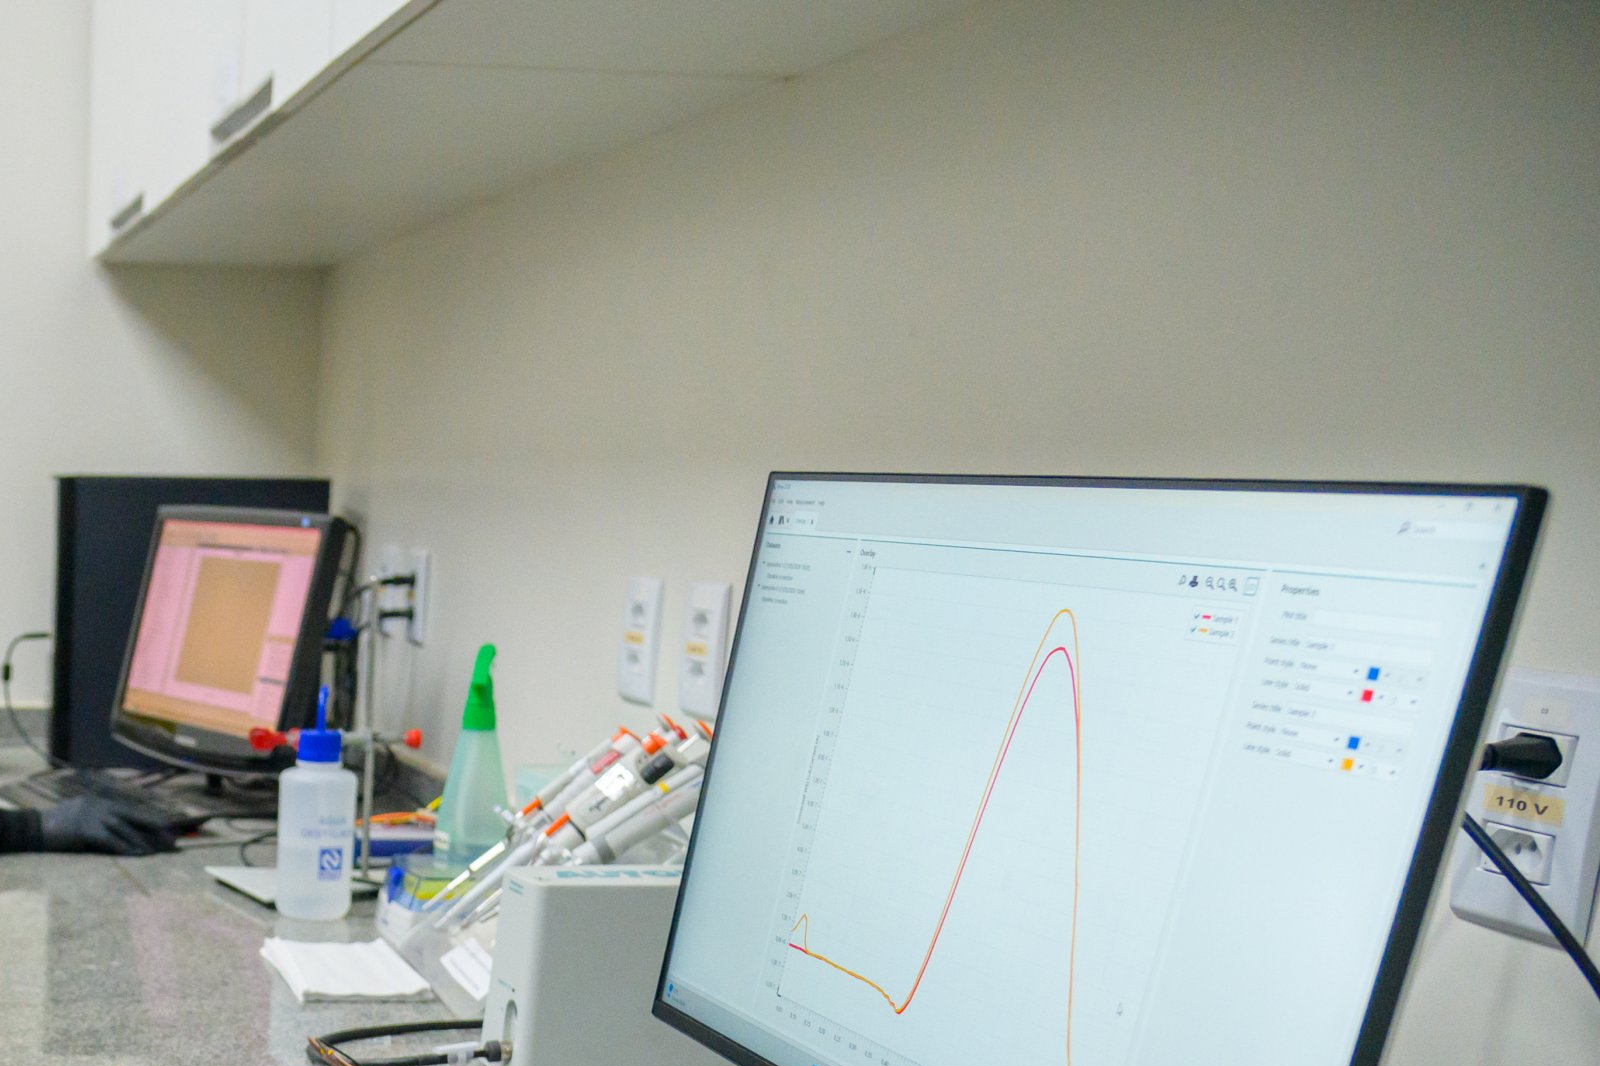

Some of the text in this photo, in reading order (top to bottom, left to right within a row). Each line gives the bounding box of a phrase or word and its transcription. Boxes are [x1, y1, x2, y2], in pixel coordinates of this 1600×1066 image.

[860, 549, 876, 559] Overlay
[1280, 584, 1321, 597] Properties
[1212, 615, 1233, 625] Sample
[1208, 628, 1230, 639] Sample
[1496, 796, 1549, 816] 110 V
